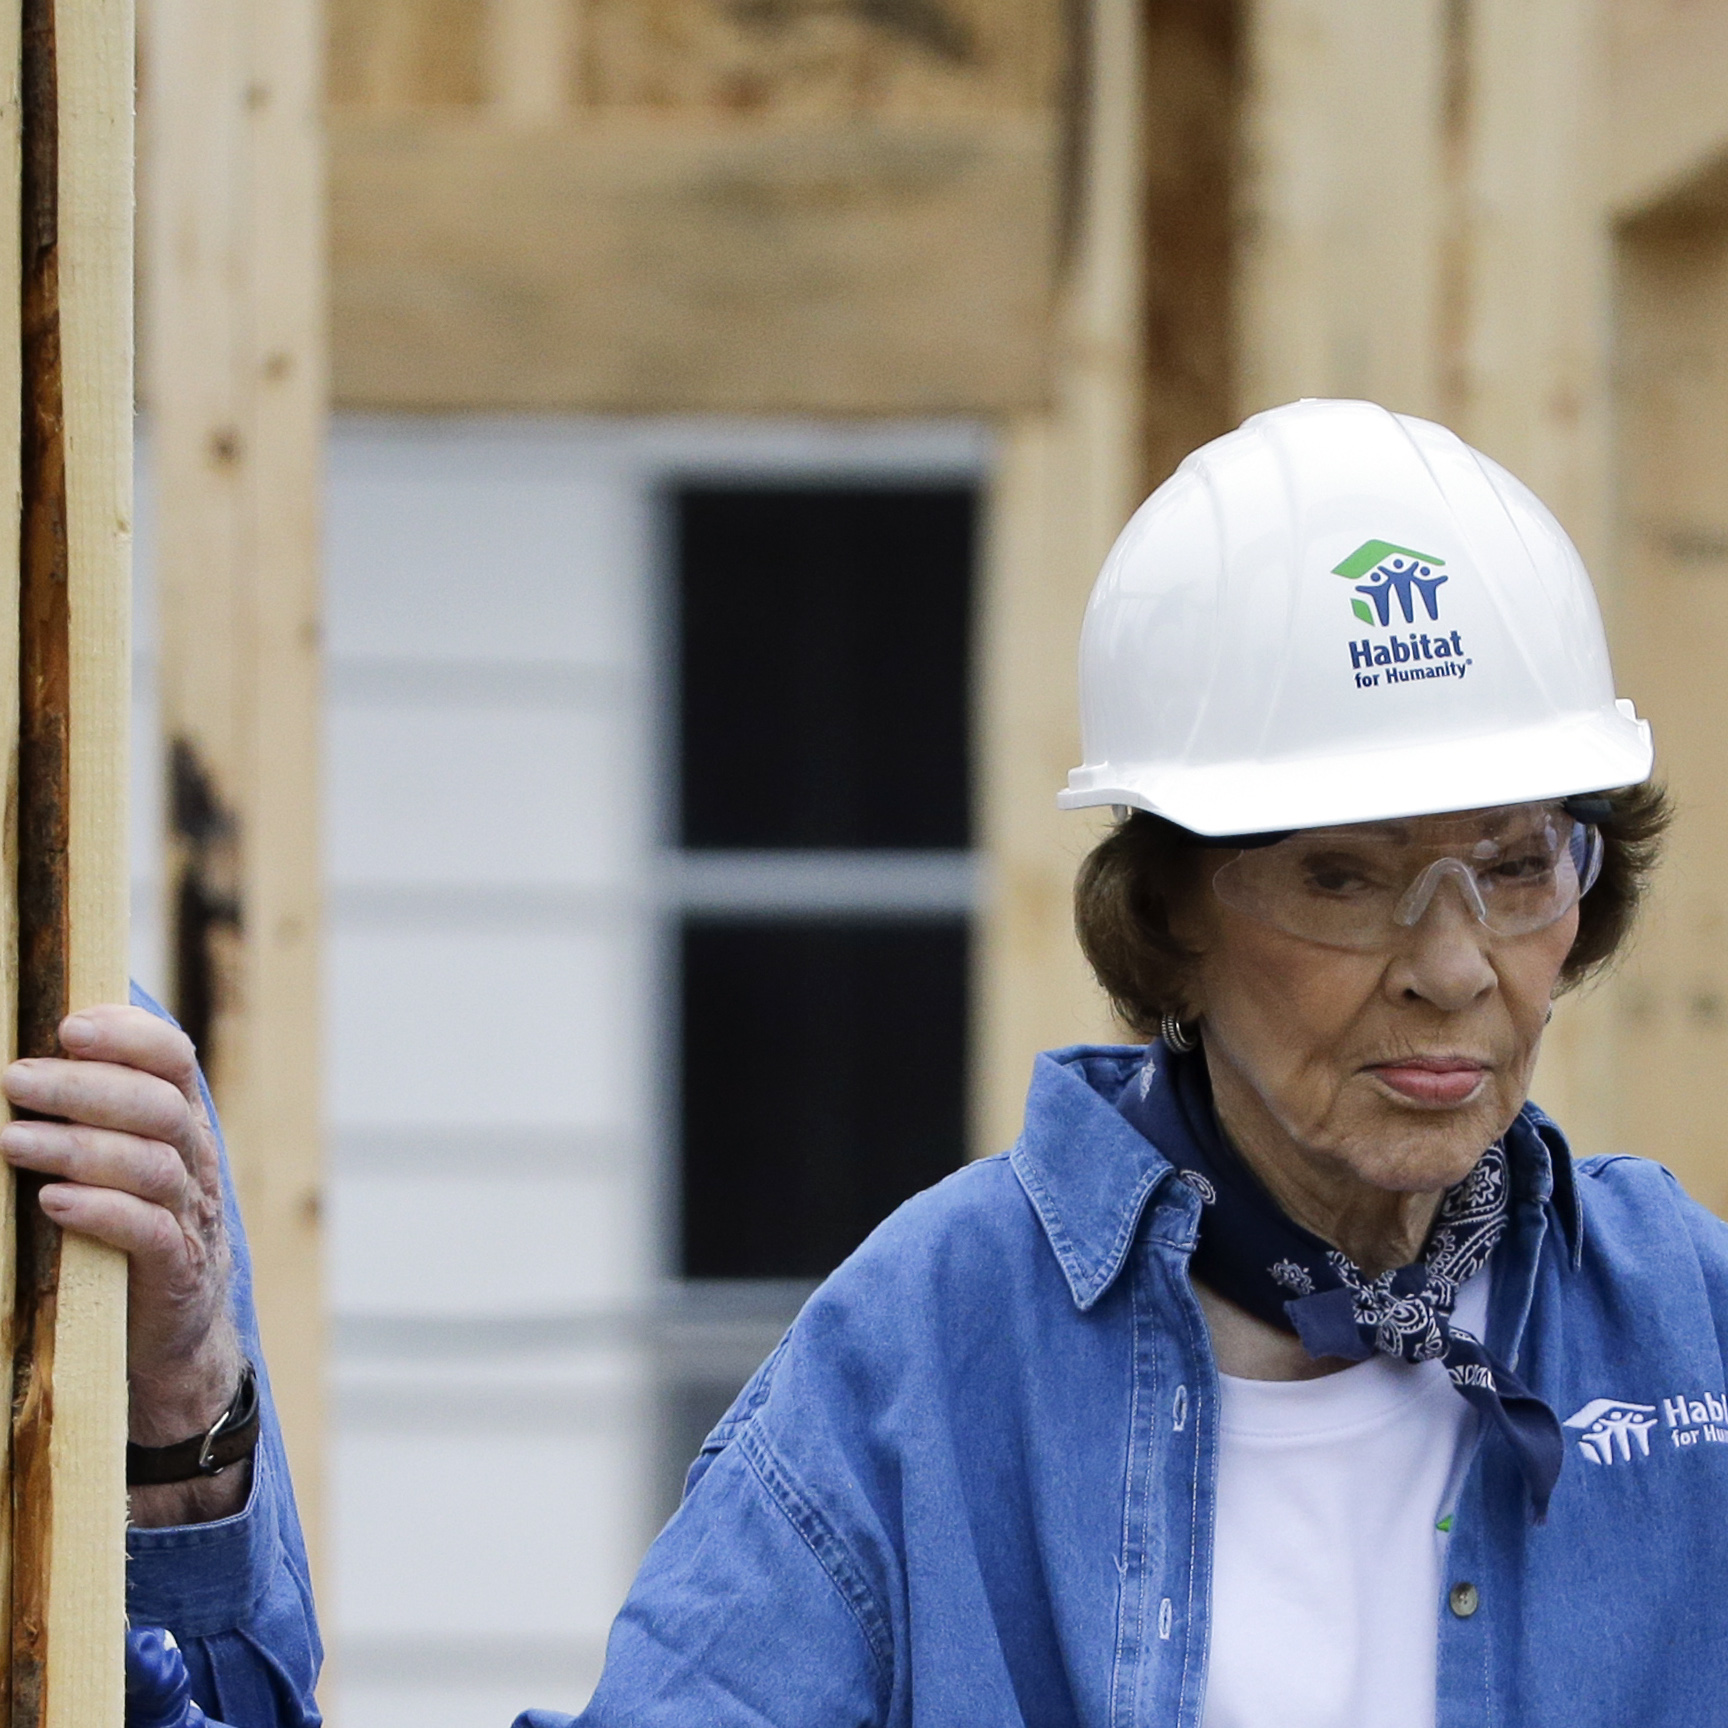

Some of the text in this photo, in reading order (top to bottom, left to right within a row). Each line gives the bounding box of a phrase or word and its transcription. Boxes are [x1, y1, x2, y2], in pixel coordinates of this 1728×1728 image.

[1348, 630, 1464, 669] Habitat
[1355, 661, 1467, 688] for Humanity
[1671, 1428, 1700, 1447] for
